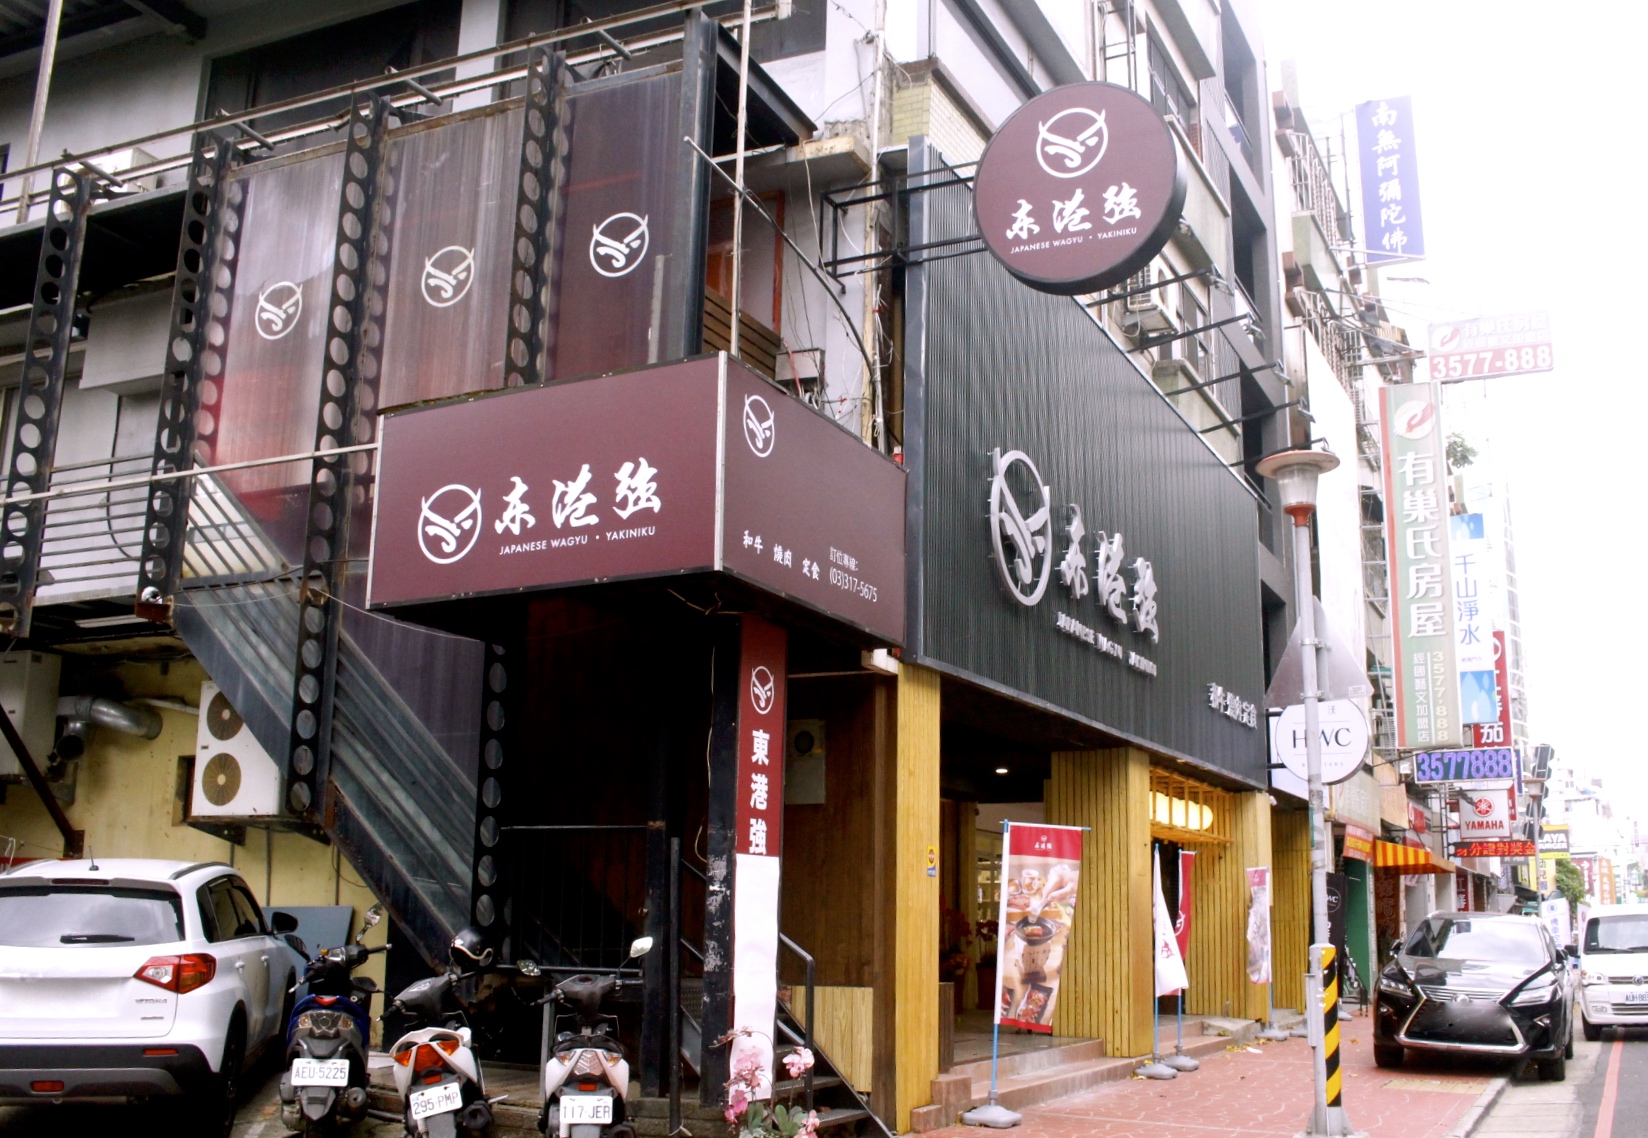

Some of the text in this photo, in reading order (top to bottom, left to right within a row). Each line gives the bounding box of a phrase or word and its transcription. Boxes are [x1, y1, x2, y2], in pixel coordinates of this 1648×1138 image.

[1371, 101, 1408, 250] 南無阿彌陀佛
[1010, 227, 1138, 254] JAPANESE WAGYU YAKINIKU
[1433, 345, 1552, 379] 3577-888
[498, 525, 656, 557] JAPANESE WAGYU YAKINIKU
[743, 530, 821, 581] 和牛 燒肉 定食
[1398, 451, 1447, 638] 有巢氏房屋
[829, 566, 878, 603] (03)317-5675
[1454, 553, 1481, 646] 千山淨水
[1416, 749, 1513, 782] 3577888
[749, 729, 771, 856] 東港強
[1464, 819, 1505, 831] YAMAHA
